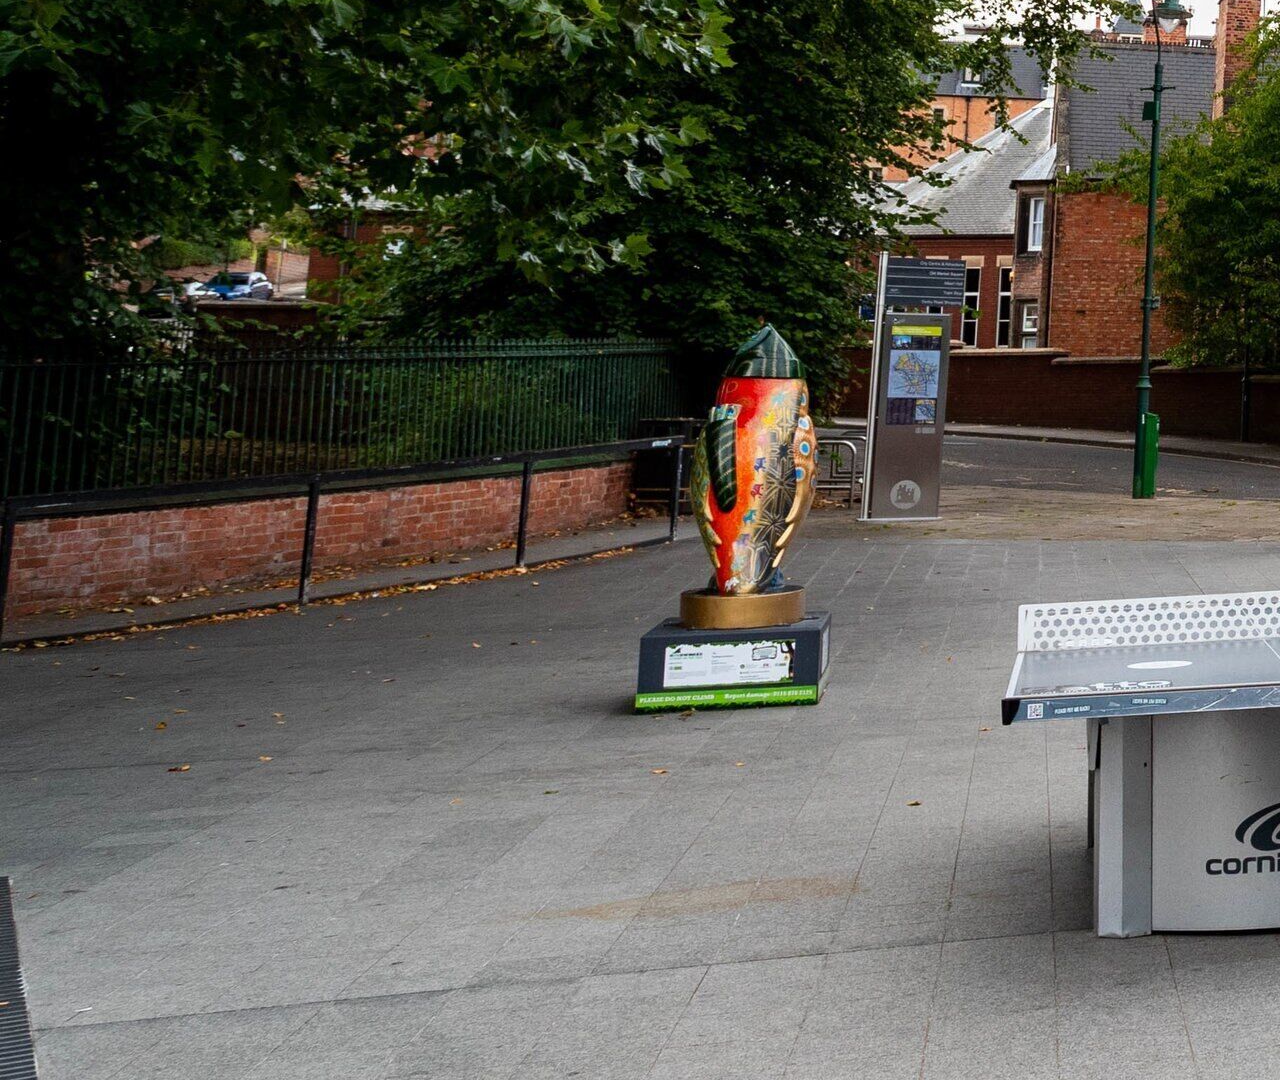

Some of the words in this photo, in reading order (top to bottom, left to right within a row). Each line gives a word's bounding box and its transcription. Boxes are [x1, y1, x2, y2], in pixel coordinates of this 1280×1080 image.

[639, 696, 664, 704] PLEASE
[692, 693, 715, 701] CLIMB
[724, 692, 745, 700] Report
